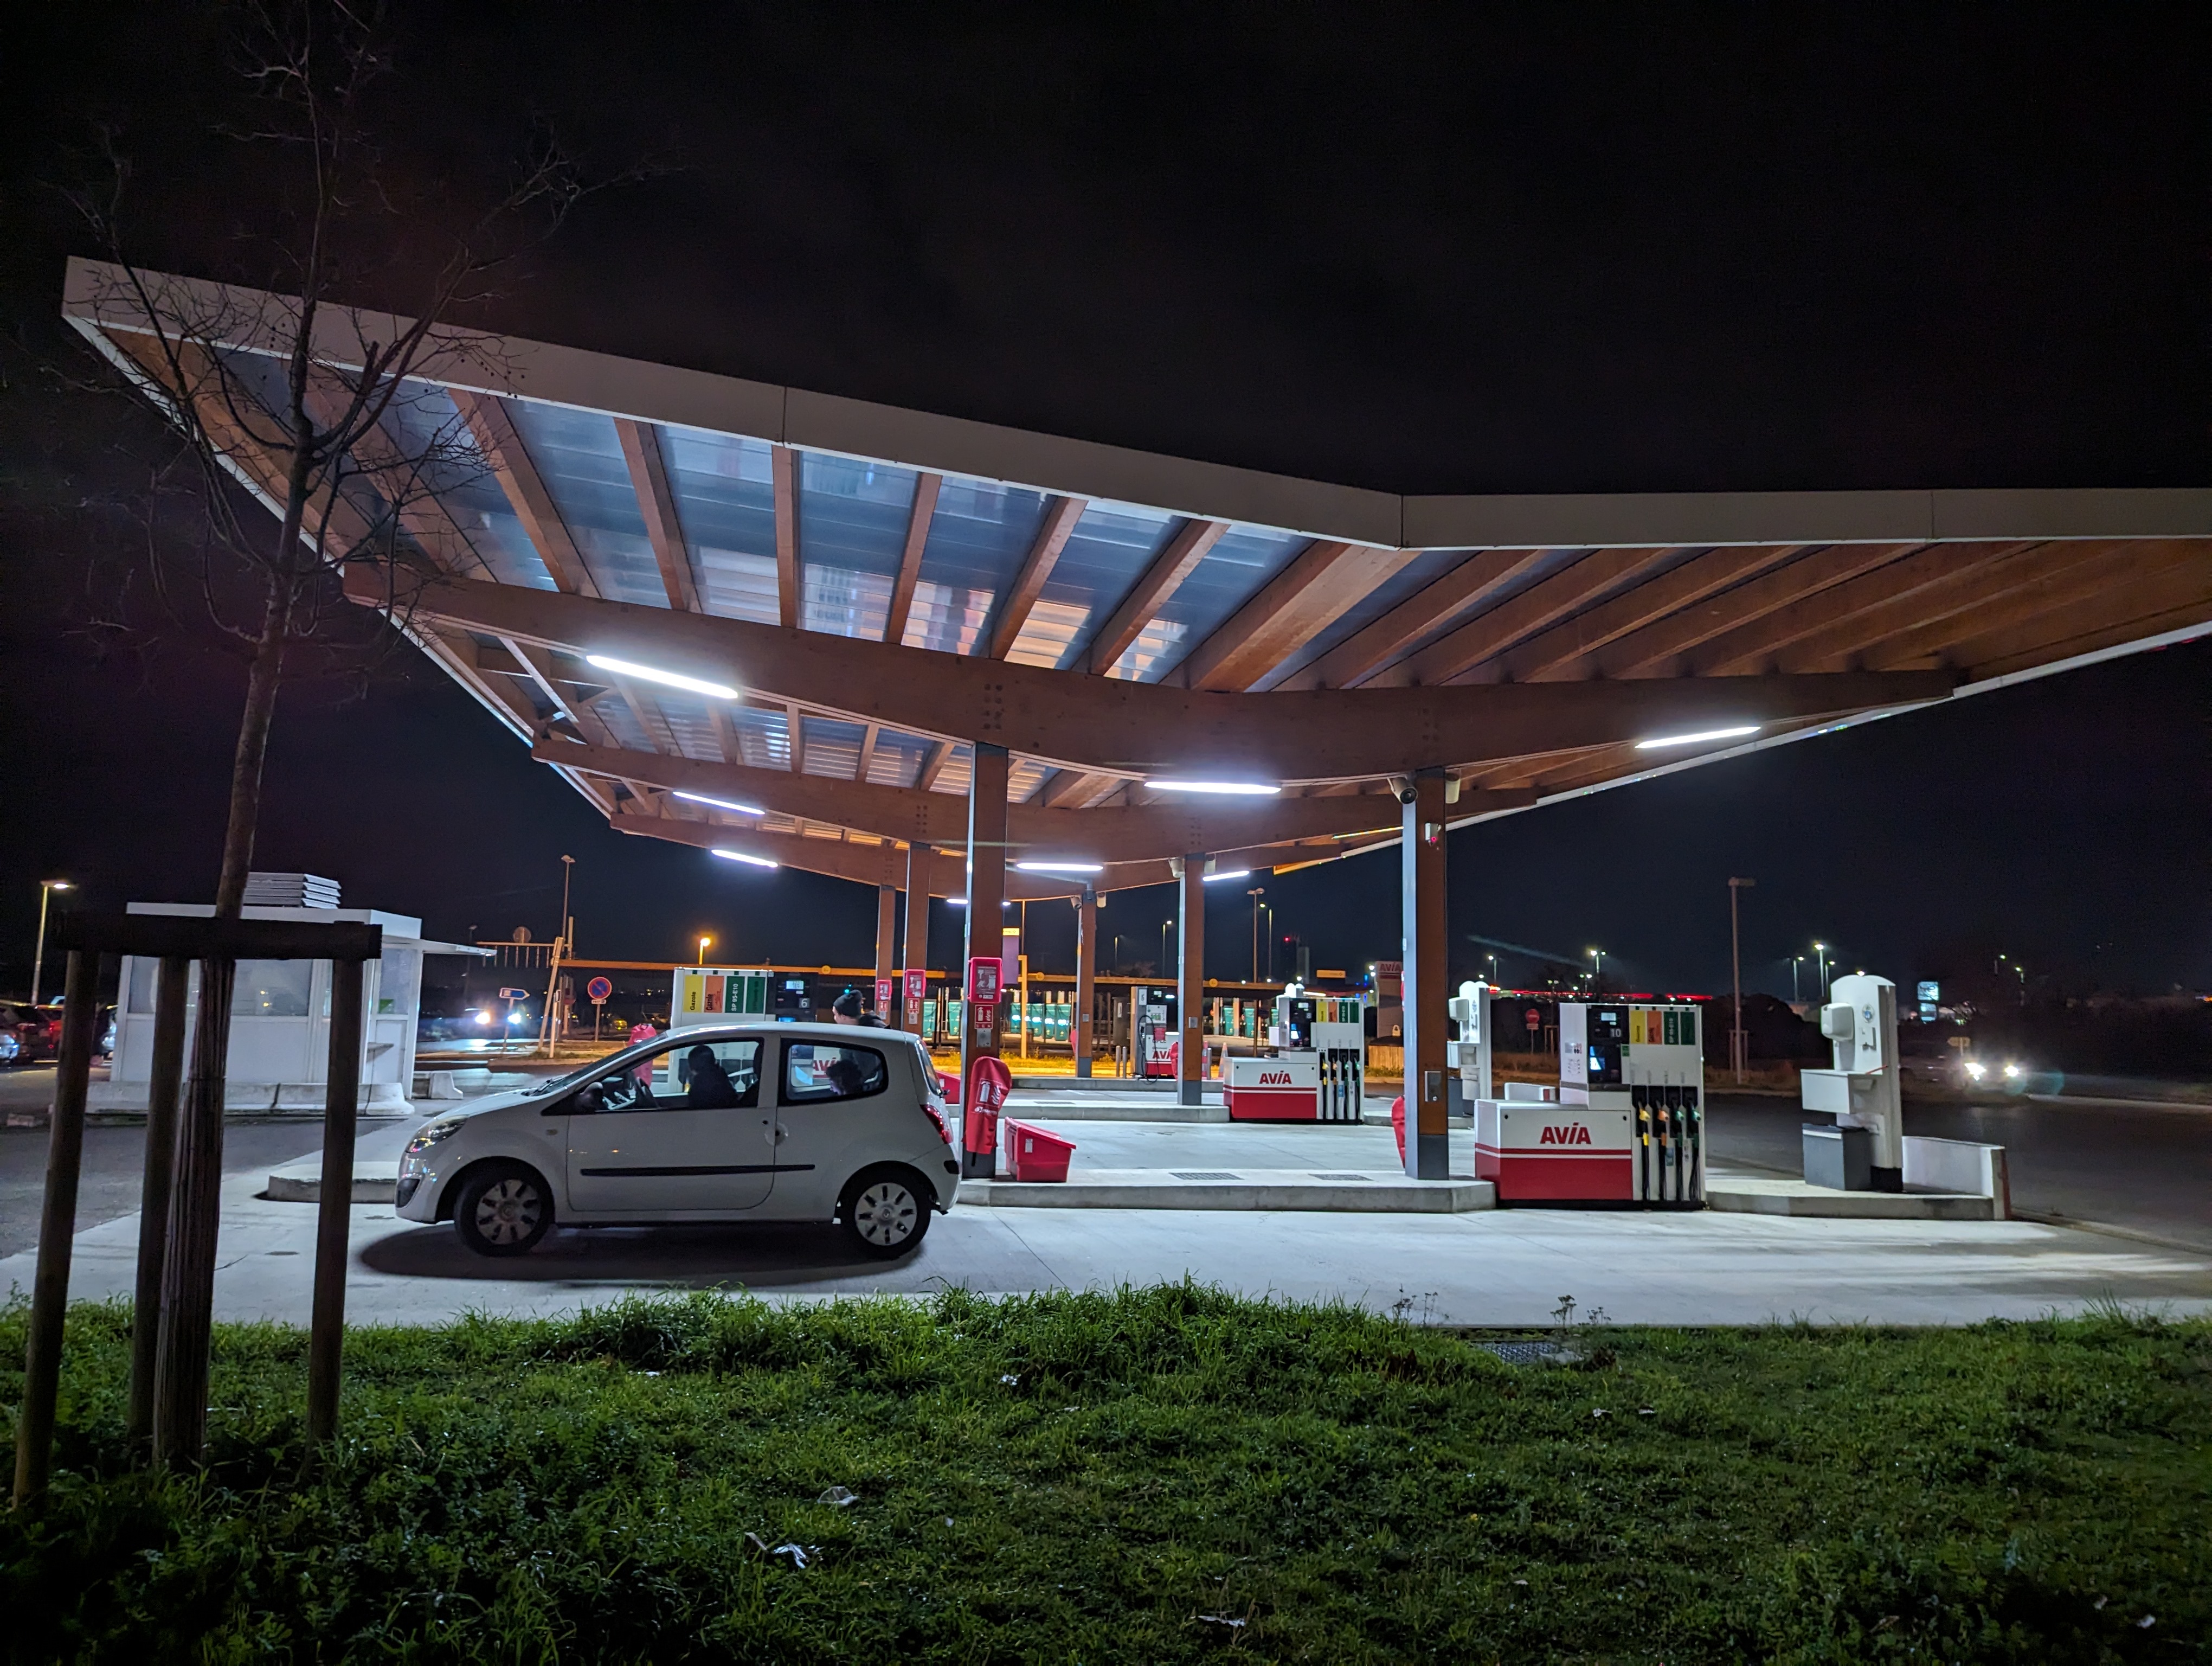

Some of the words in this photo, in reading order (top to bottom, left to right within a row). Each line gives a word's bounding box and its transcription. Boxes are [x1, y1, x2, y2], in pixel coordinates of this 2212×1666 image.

[801, 998, 808, 1008] 6
[1611, 1028, 1621, 1037] 10
[1152, 1049, 1171, 1059] AVI
